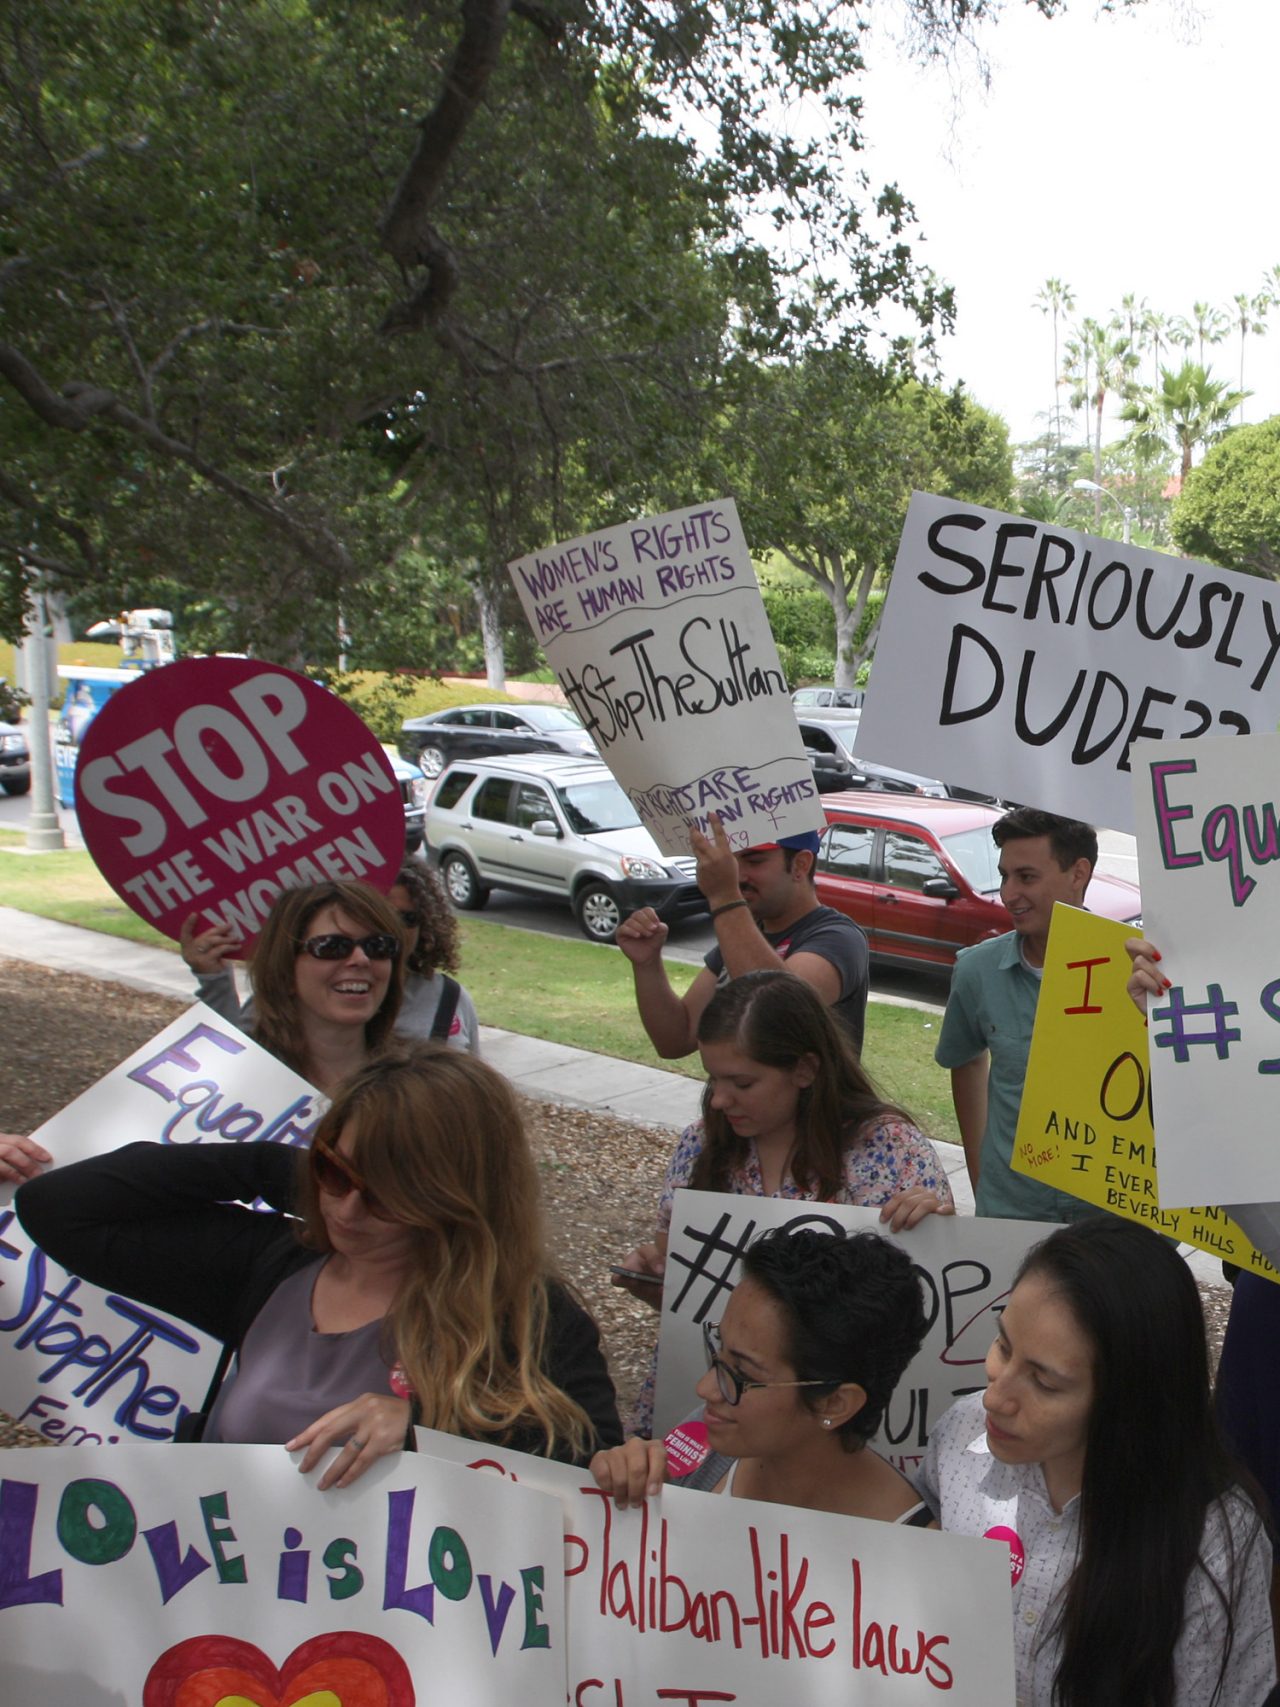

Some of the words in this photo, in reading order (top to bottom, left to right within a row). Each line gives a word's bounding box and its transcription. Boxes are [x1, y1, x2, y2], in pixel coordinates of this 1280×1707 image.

[519, 540, 619, 601] WOMEN'S
[631, 510, 731, 563] RIGHTS
[534, 600, 572, 635] ARE
[577, 575, 645, 620] HUMAN
[656, 555, 736, 597] RIGHTS
[559, 616, 787, 750] #StopTheSultan
[79, 672, 310, 858] STOP
[697, 766, 761, 808] ARE
[748, 778, 815, 813] RIGHTS
[122, 849, 215, 919] THE
[202, 791, 324, 874] WAR
[318, 752, 396, 819] ON
[200, 827, 387, 942] WOMEN
[1064, 957, 1111, 1015] I
[1028, 1144, 1062, 1169] MORE!
[1045, 1111, 1097, 1145] AND
[1071, 1154, 1090, 1172] I
[1106, 1188, 1180, 1231] BEVERLY
[1193, 1226, 1235, 1254] HILLS
[1250, 1250, 1280, 1274] HO
[665, 1433, 706, 1463] FEMINIST
[0, 1477, 249, 1608] LOVE
[277, 1526, 365, 1604] is
[382, 1486, 553, 1658] LOVE
[579, 1486, 837, 1660] Taliban-like
[852, 1558, 954, 1691] laws
